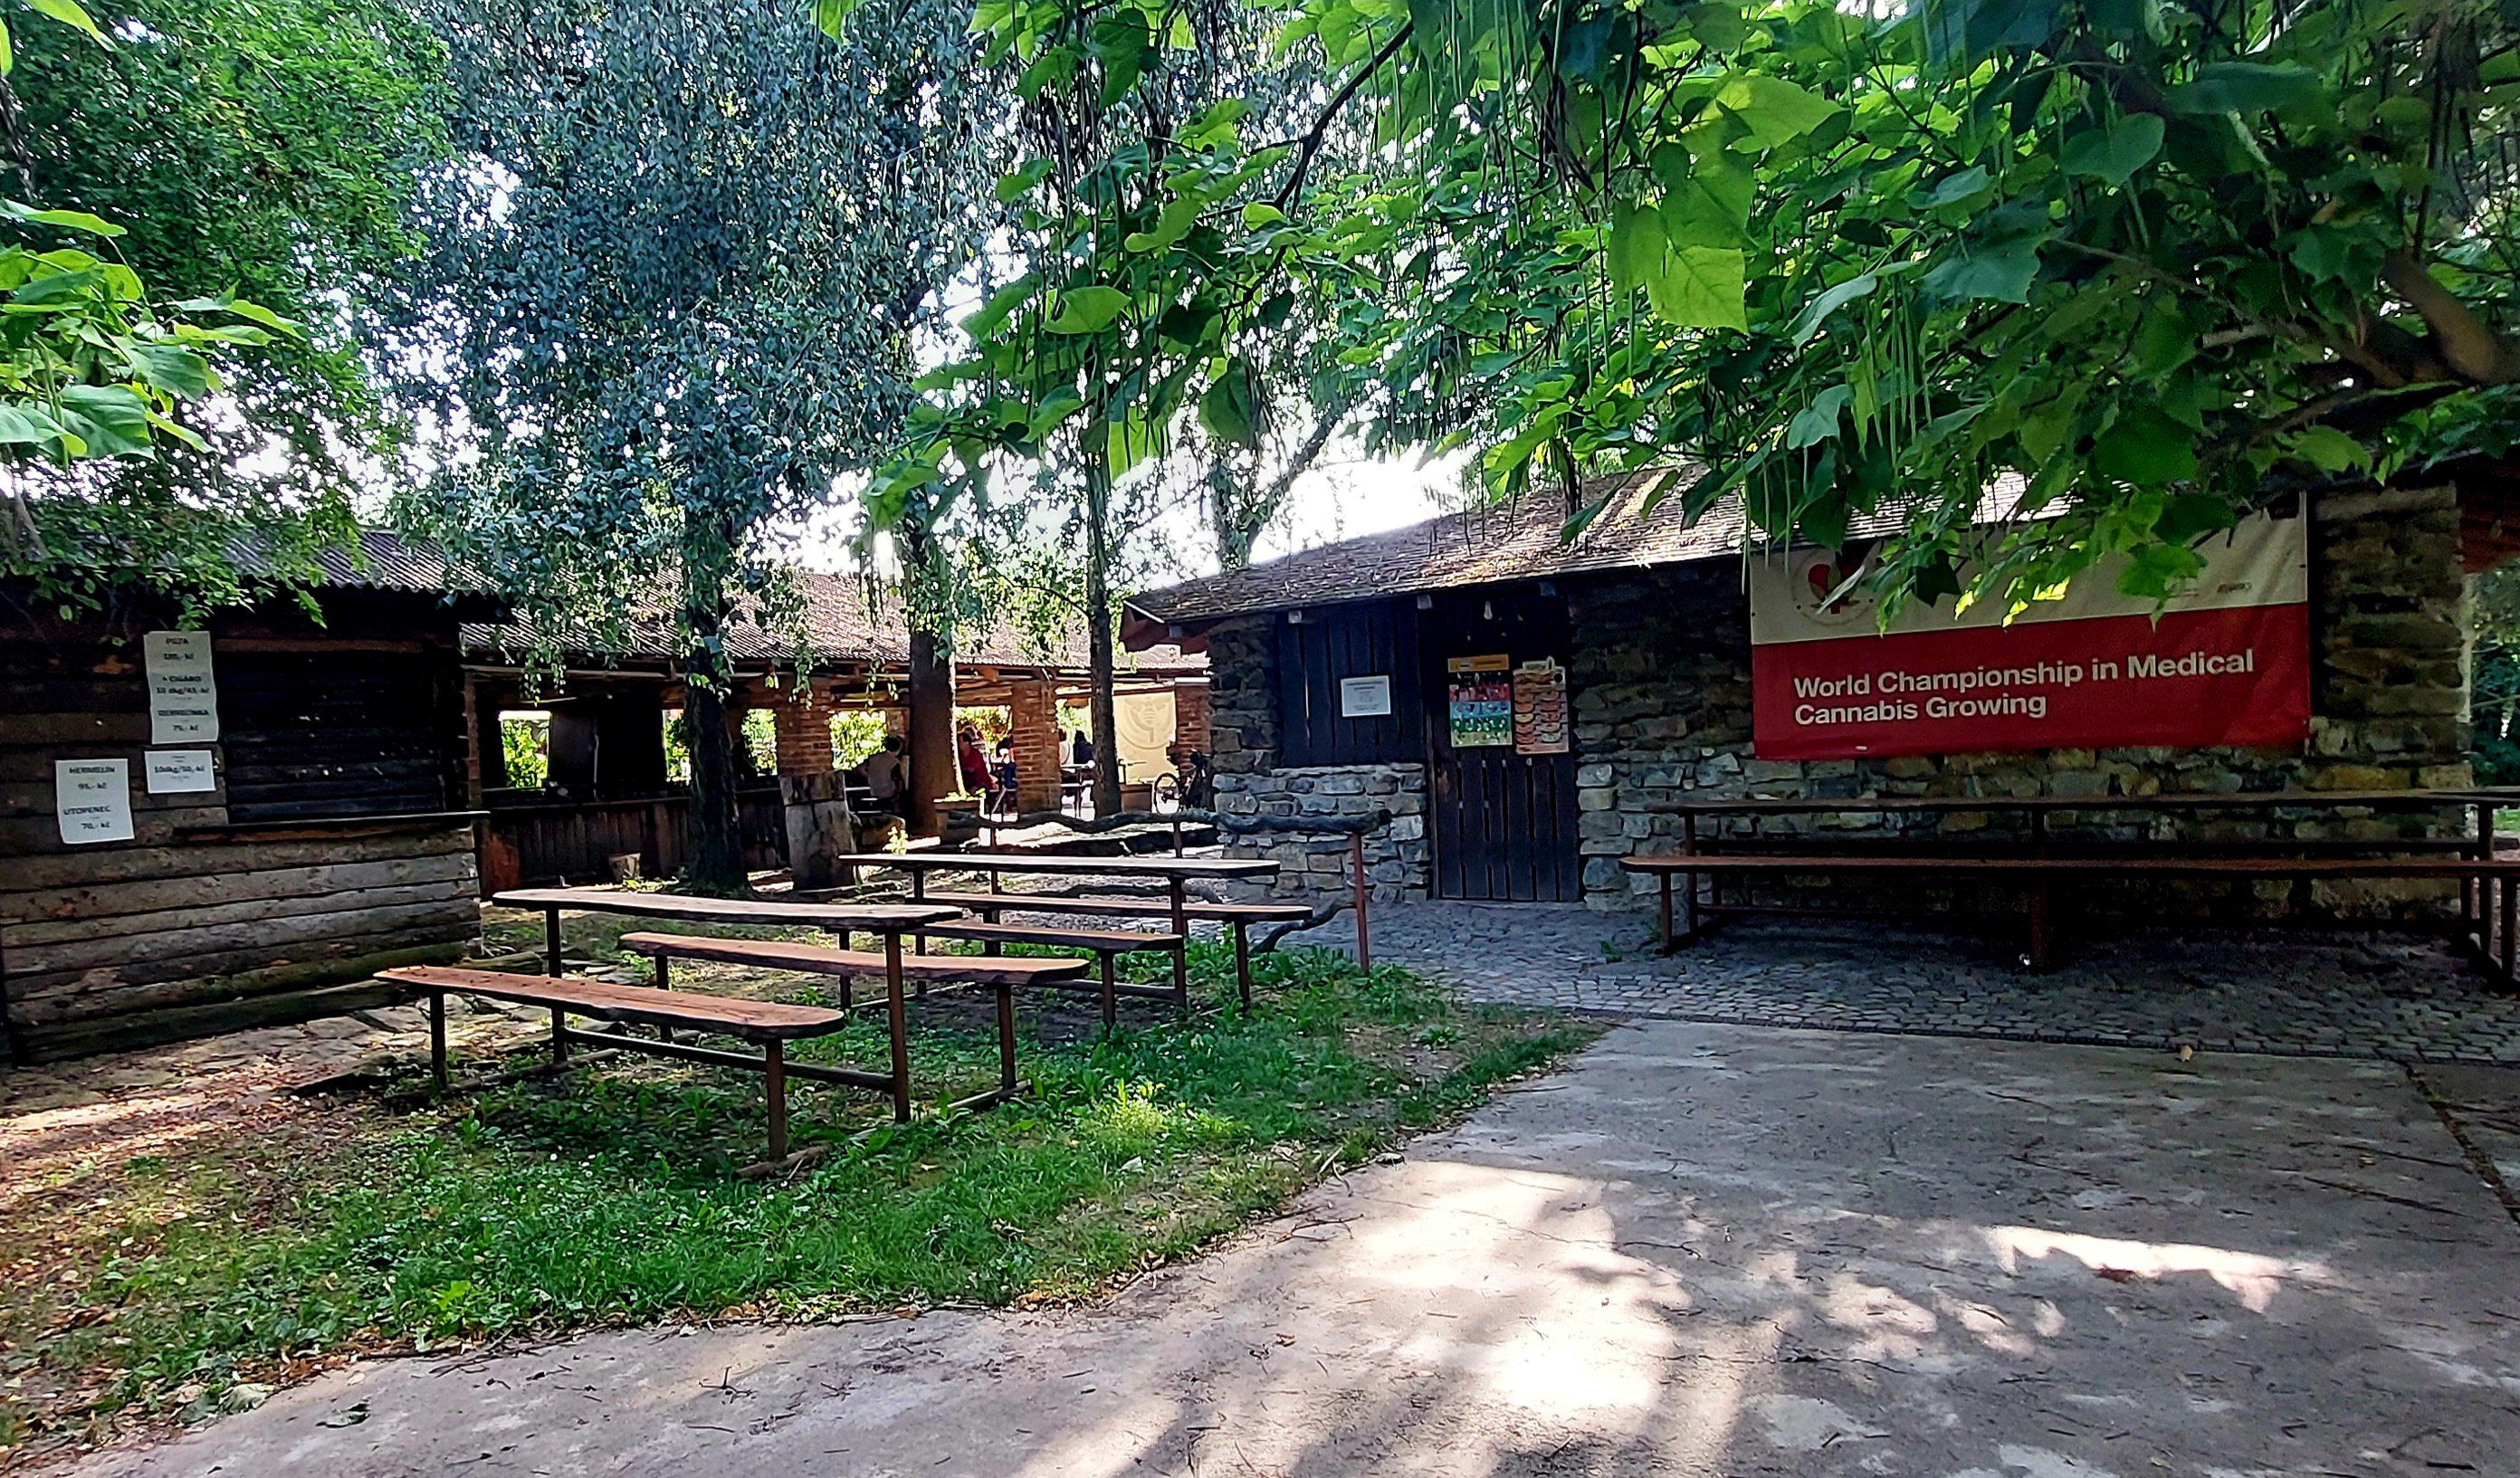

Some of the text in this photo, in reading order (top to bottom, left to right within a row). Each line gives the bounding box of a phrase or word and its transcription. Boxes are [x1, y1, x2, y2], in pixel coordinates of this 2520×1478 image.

[1794, 648, 2254, 699] World Championship in Medical
[1795, 692, 2047, 725] Cannabis Growing
